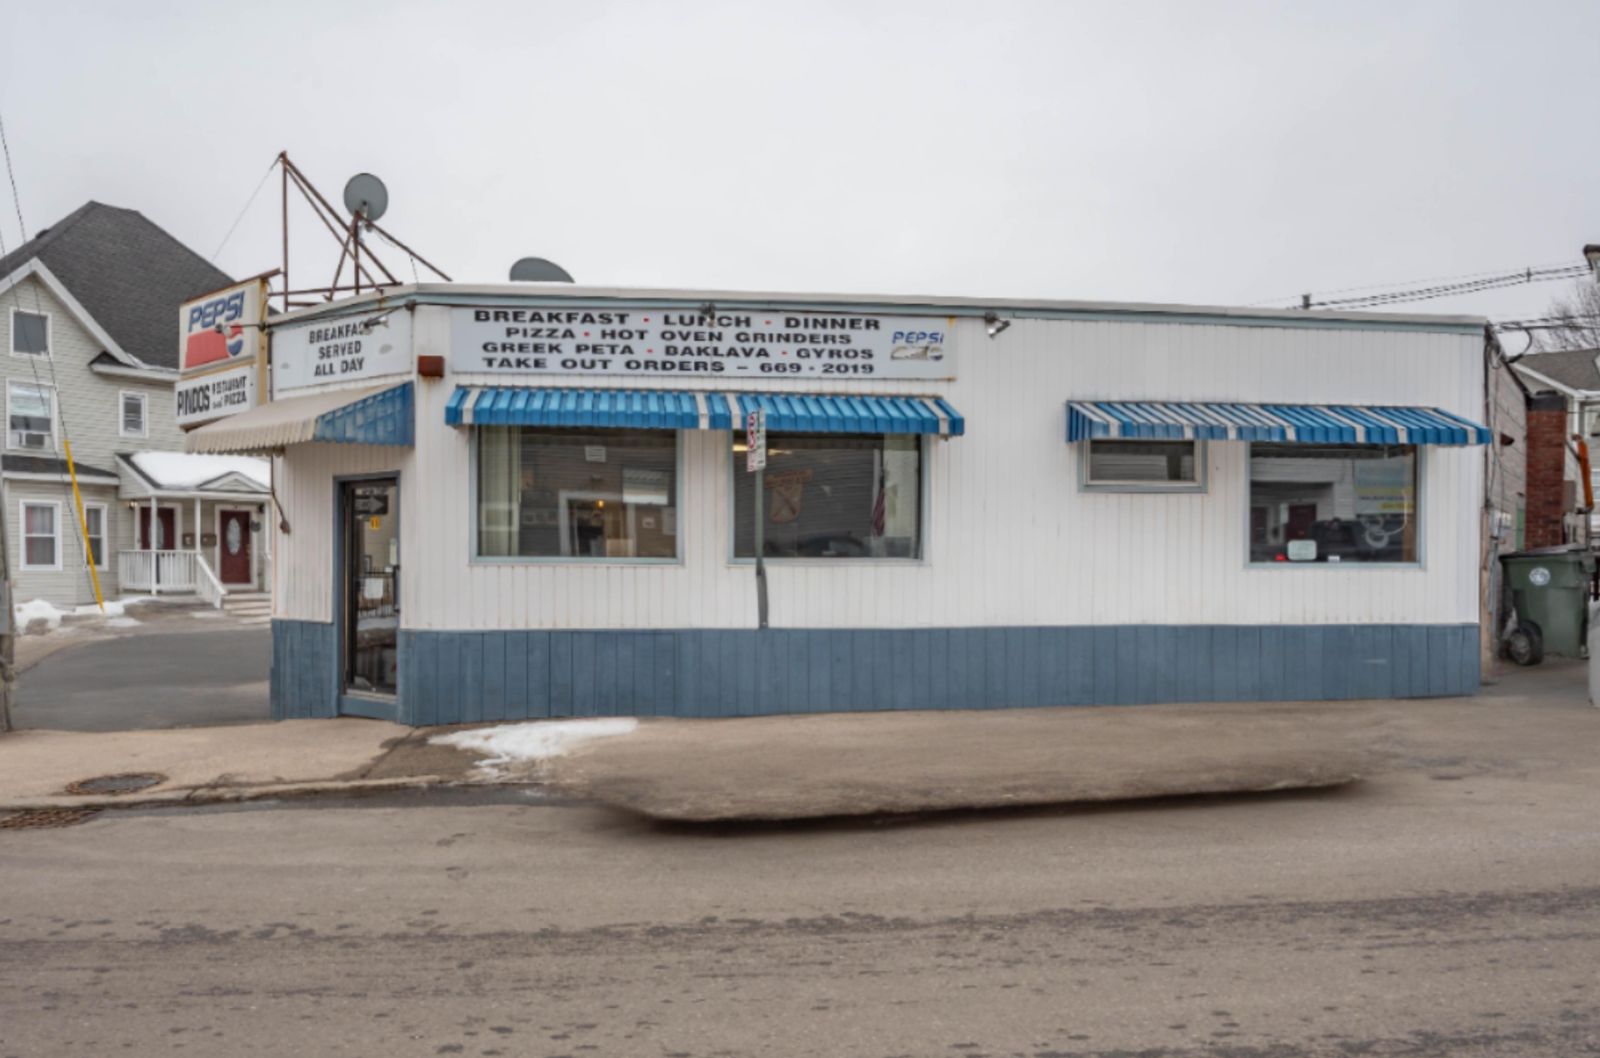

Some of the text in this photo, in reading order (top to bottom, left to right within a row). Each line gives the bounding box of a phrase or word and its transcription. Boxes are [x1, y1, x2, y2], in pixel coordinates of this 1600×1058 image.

[188, 290, 245, 333] PEPSI
[474, 309, 630, 325] BREAKFAST
[784, 317, 881, 331] DINNER
[308, 321, 369, 344] BREAKFAS
[505, 327, 853, 345] PIZZA HOT OVEN GRINDERS
[891, 331, 945, 344] PEPSI
[318, 340, 363, 360] SERVED
[482, 342, 874, 360] GREEK PETA BAKLAVA GYROS
[314, 357, 365, 377] ALL DAY
[483, 357, 548, 369] TAKE
[560, 358, 613, 370] OUT
[624, 360, 726, 373] ORDERS
[760, 363, 802, 374] 669
[821, 363, 875, 375] 2019
